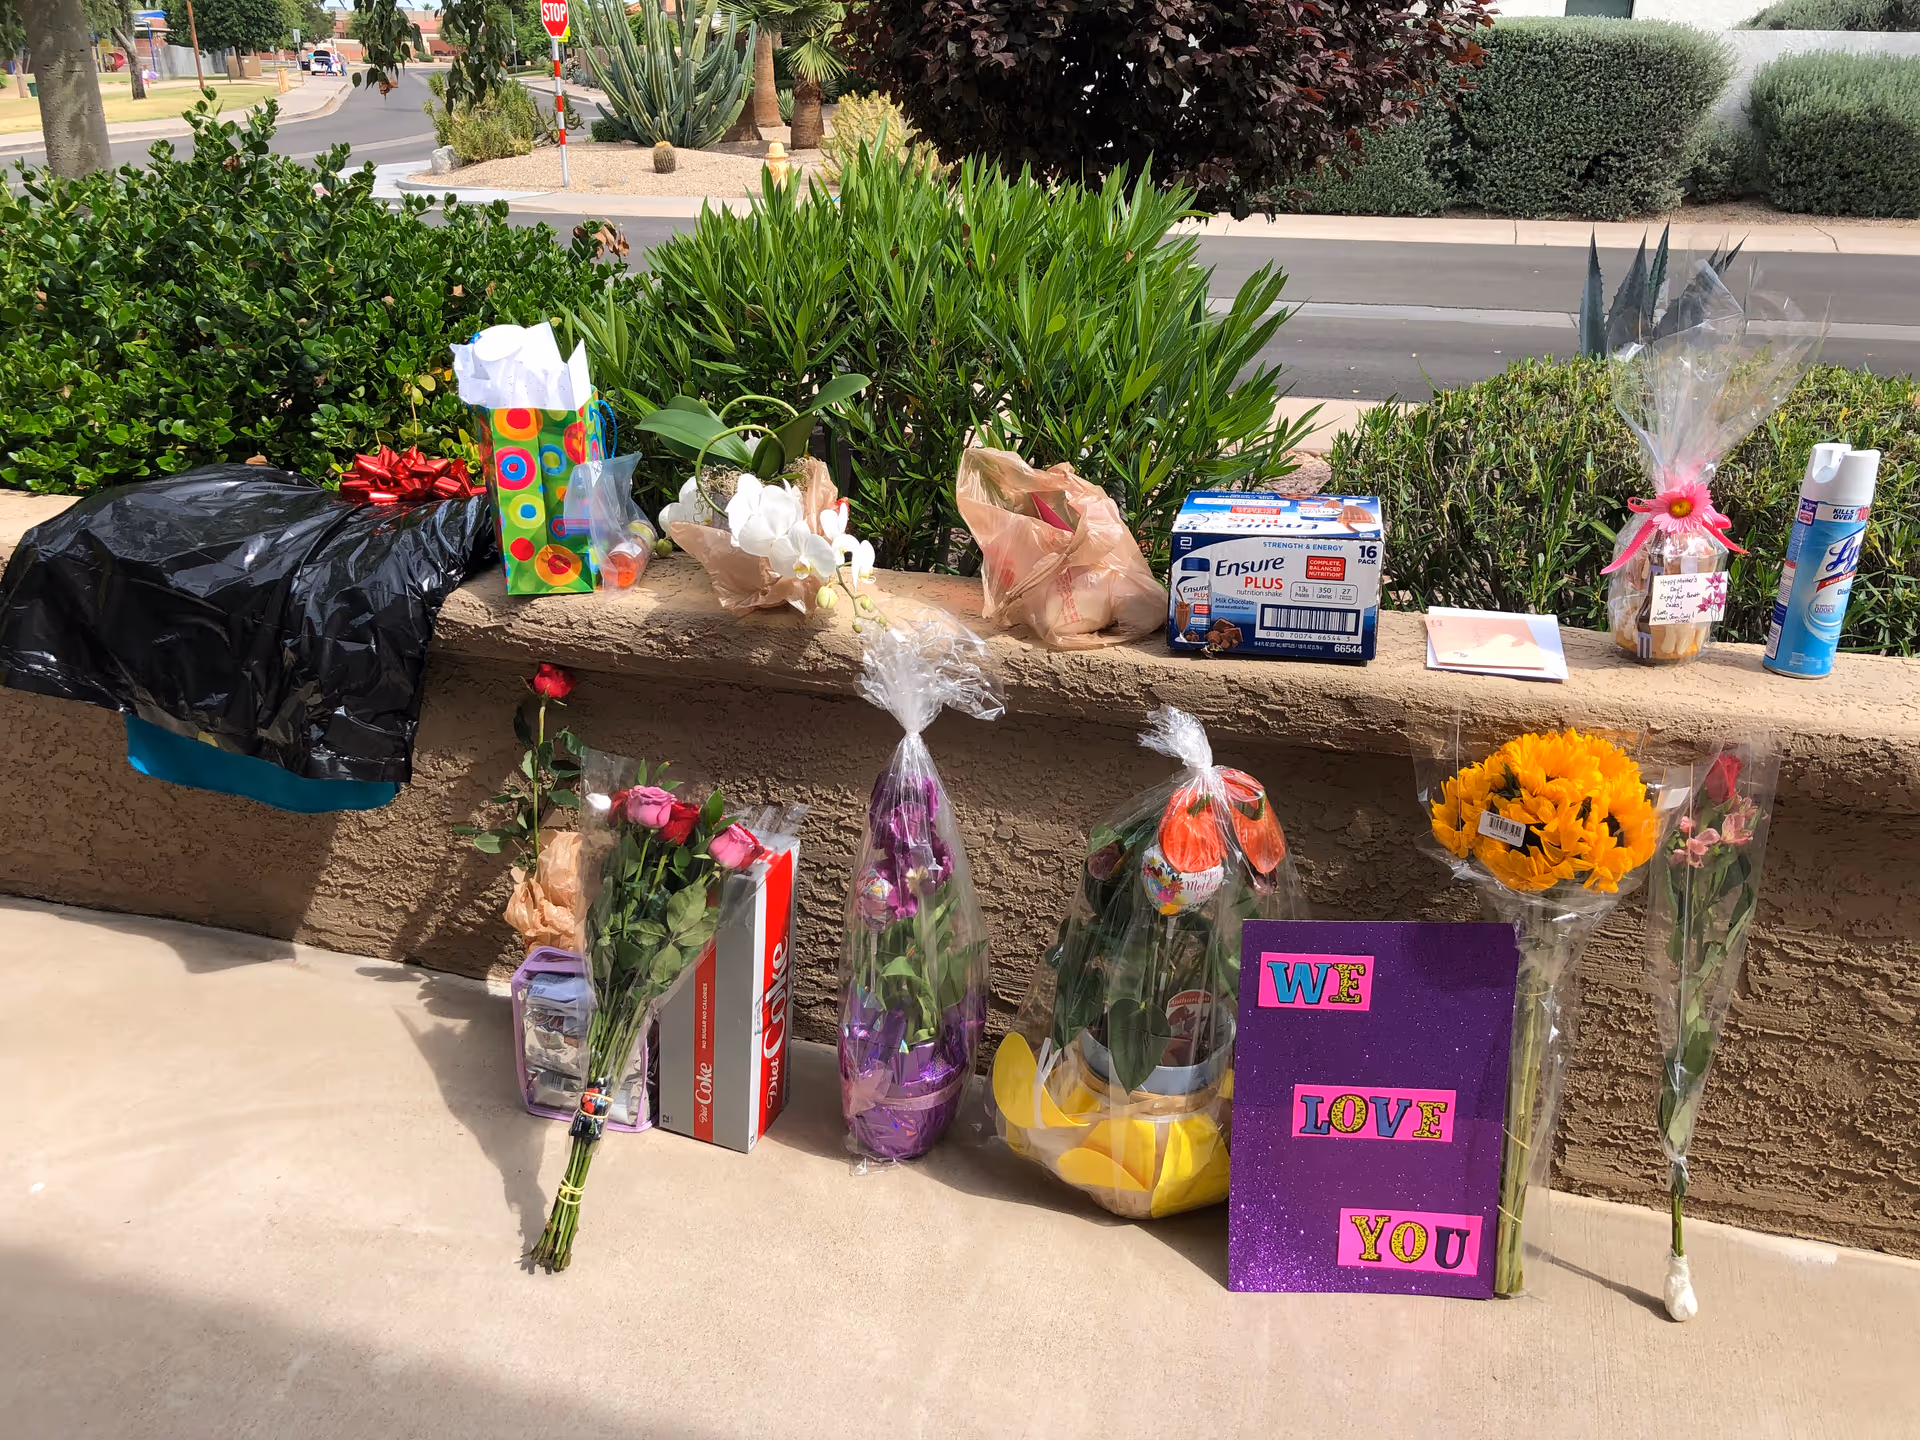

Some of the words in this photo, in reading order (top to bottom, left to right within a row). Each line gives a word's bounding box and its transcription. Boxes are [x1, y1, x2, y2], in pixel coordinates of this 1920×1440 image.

[543, 2, 566, 22] STOP
[1263, 541, 1304, 550] STRENGTH
[1312, 544, 1344, 552] ENERGY
[1359, 545, 1377, 559] 16
[1215, 557, 1284, 577] Ensure
[1182, 584, 1210, 594] Ensure
[1244, 576, 1283, 590] PLUS
[1660, 578, 1676, 586] Happy
[1236, 589, 1264, 597] nutrition
[1264, 590, 1283, 598] shake
[1228, 598, 1255, 606] Chocolate
[1290, 632, 1312, 640] 70074
[1334, 644, 1362, 654] 66544
[1266, 961, 1367, 1005] WE
[764, 935, 789, 1060] Coke
[702, 1010, 708, 1020] NO
[702, 1040, 707, 1050] NO
[695, 1062, 713, 1105] Coke
[766, 1058, 780, 1109] Diet
[662, 1114, 670, 1123] 12
[698, 1104, 709, 1124] Diet
[1300, 1094, 1449, 1139] LOVE
[1350, 1214, 1471, 1269] YOU
